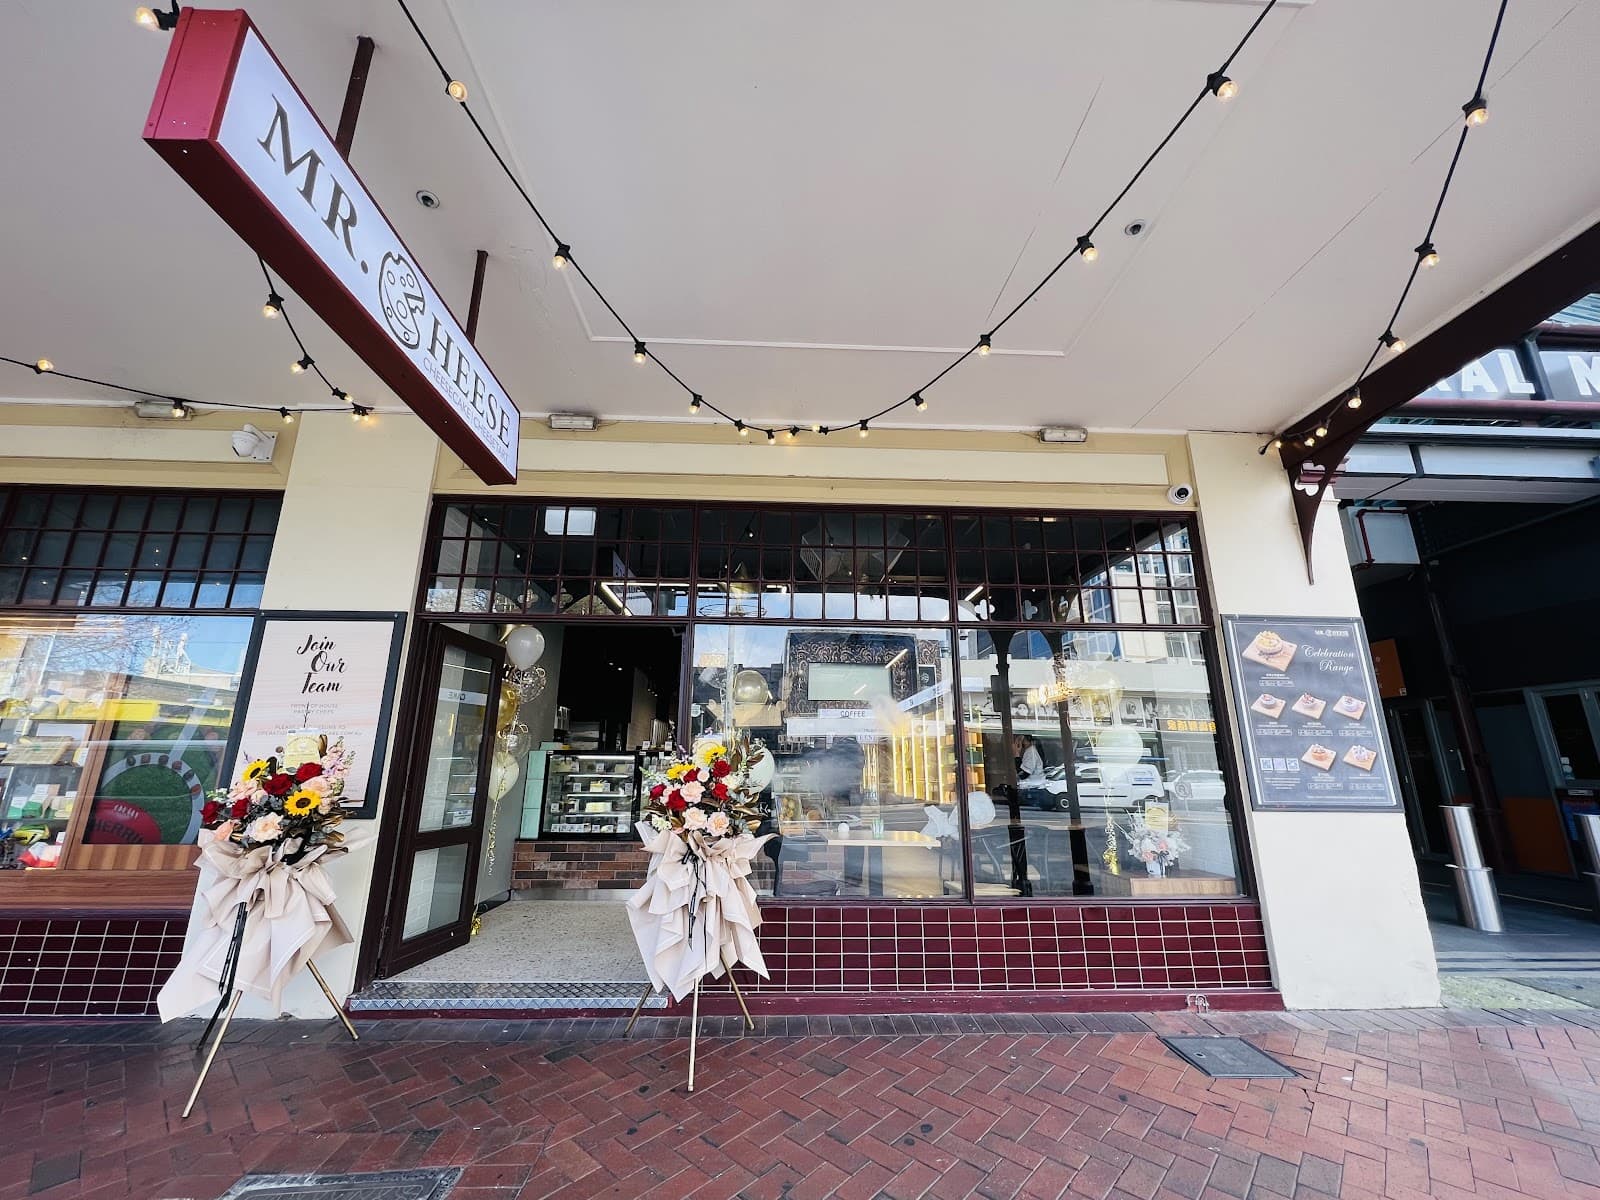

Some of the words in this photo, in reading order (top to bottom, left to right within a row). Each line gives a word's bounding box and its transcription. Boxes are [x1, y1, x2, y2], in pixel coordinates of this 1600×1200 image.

[256, 94, 370, 274] MR.
[297, 634, 336, 655] Join
[1301, 644, 1354, 658] Celebration
[310, 651, 346, 674] Our
[1319, 659, 1354, 676] Range
[301, 672, 342, 694] Team
[840, 710, 865, 718] COFFEE
